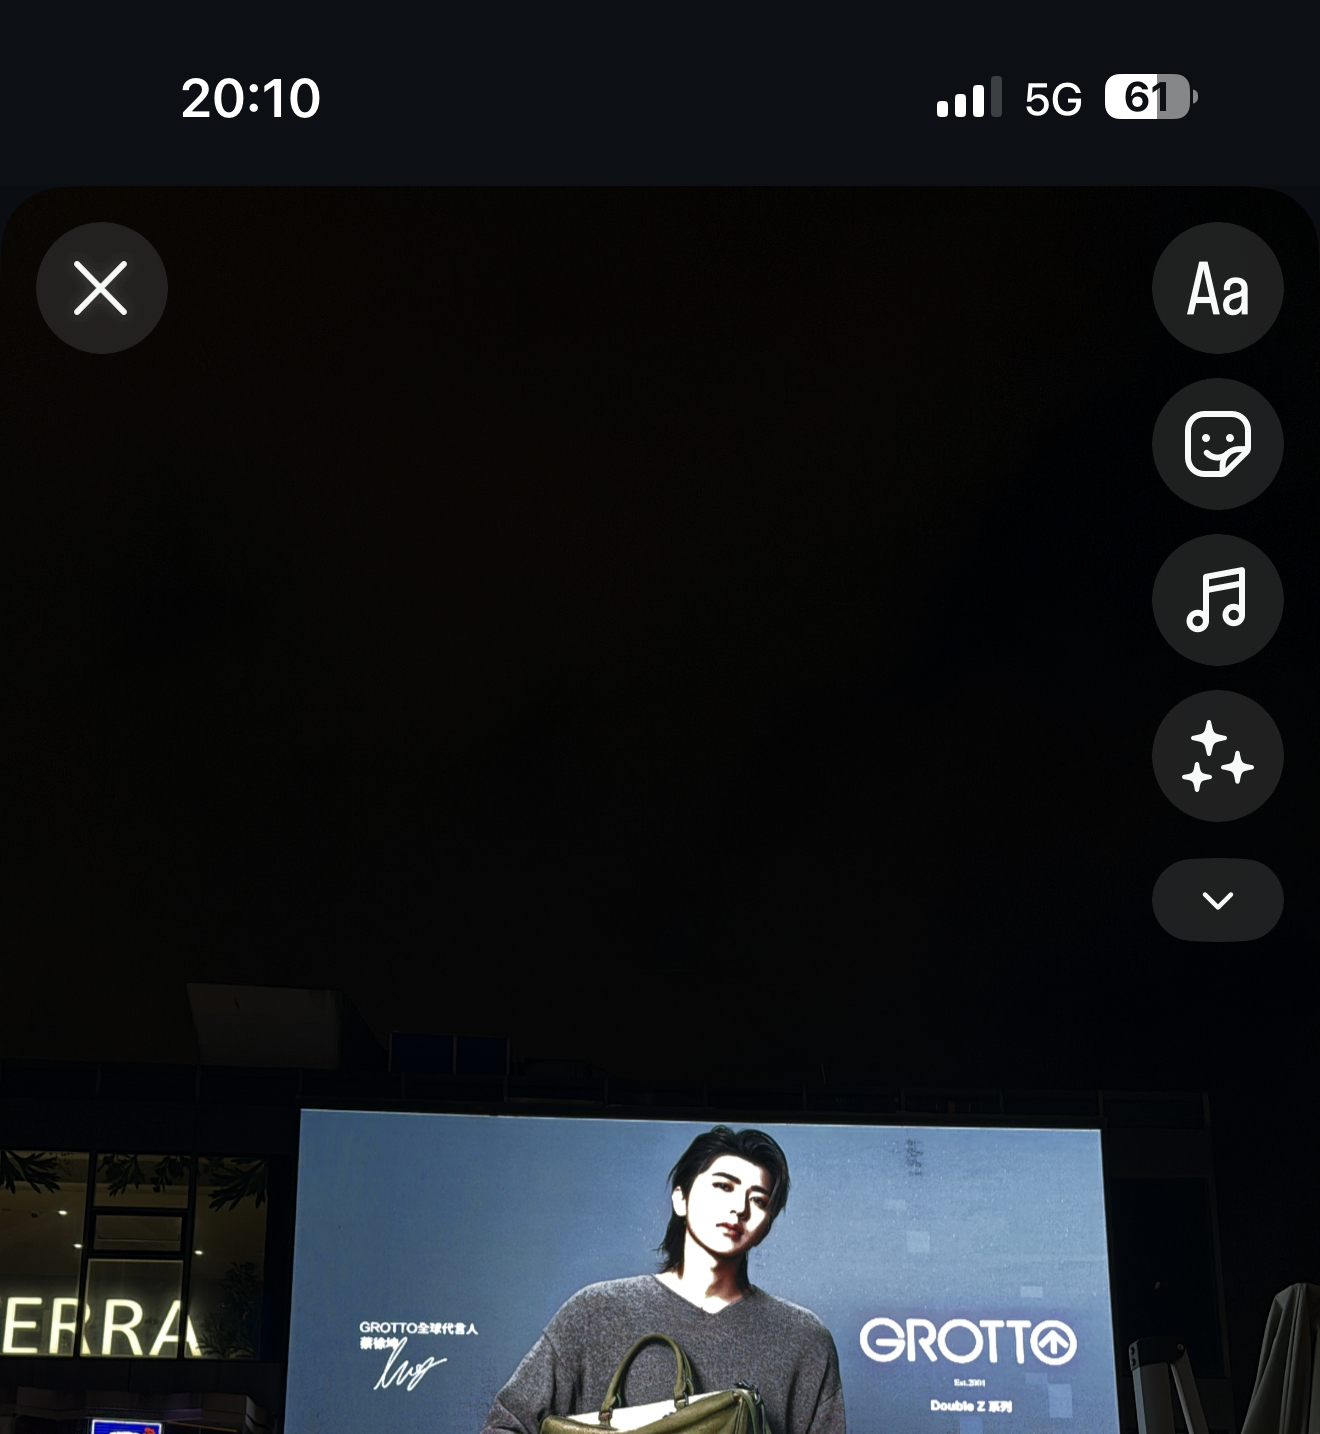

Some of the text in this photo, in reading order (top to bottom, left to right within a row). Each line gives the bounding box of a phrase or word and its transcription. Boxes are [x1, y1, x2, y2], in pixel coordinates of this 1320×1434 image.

[359, 1321, 479, 1336] GROTTO全球代言人
[859, 1317, 1077, 1366] GROTTO
[930, 1399, 1013, 1413] Double Z 系列
